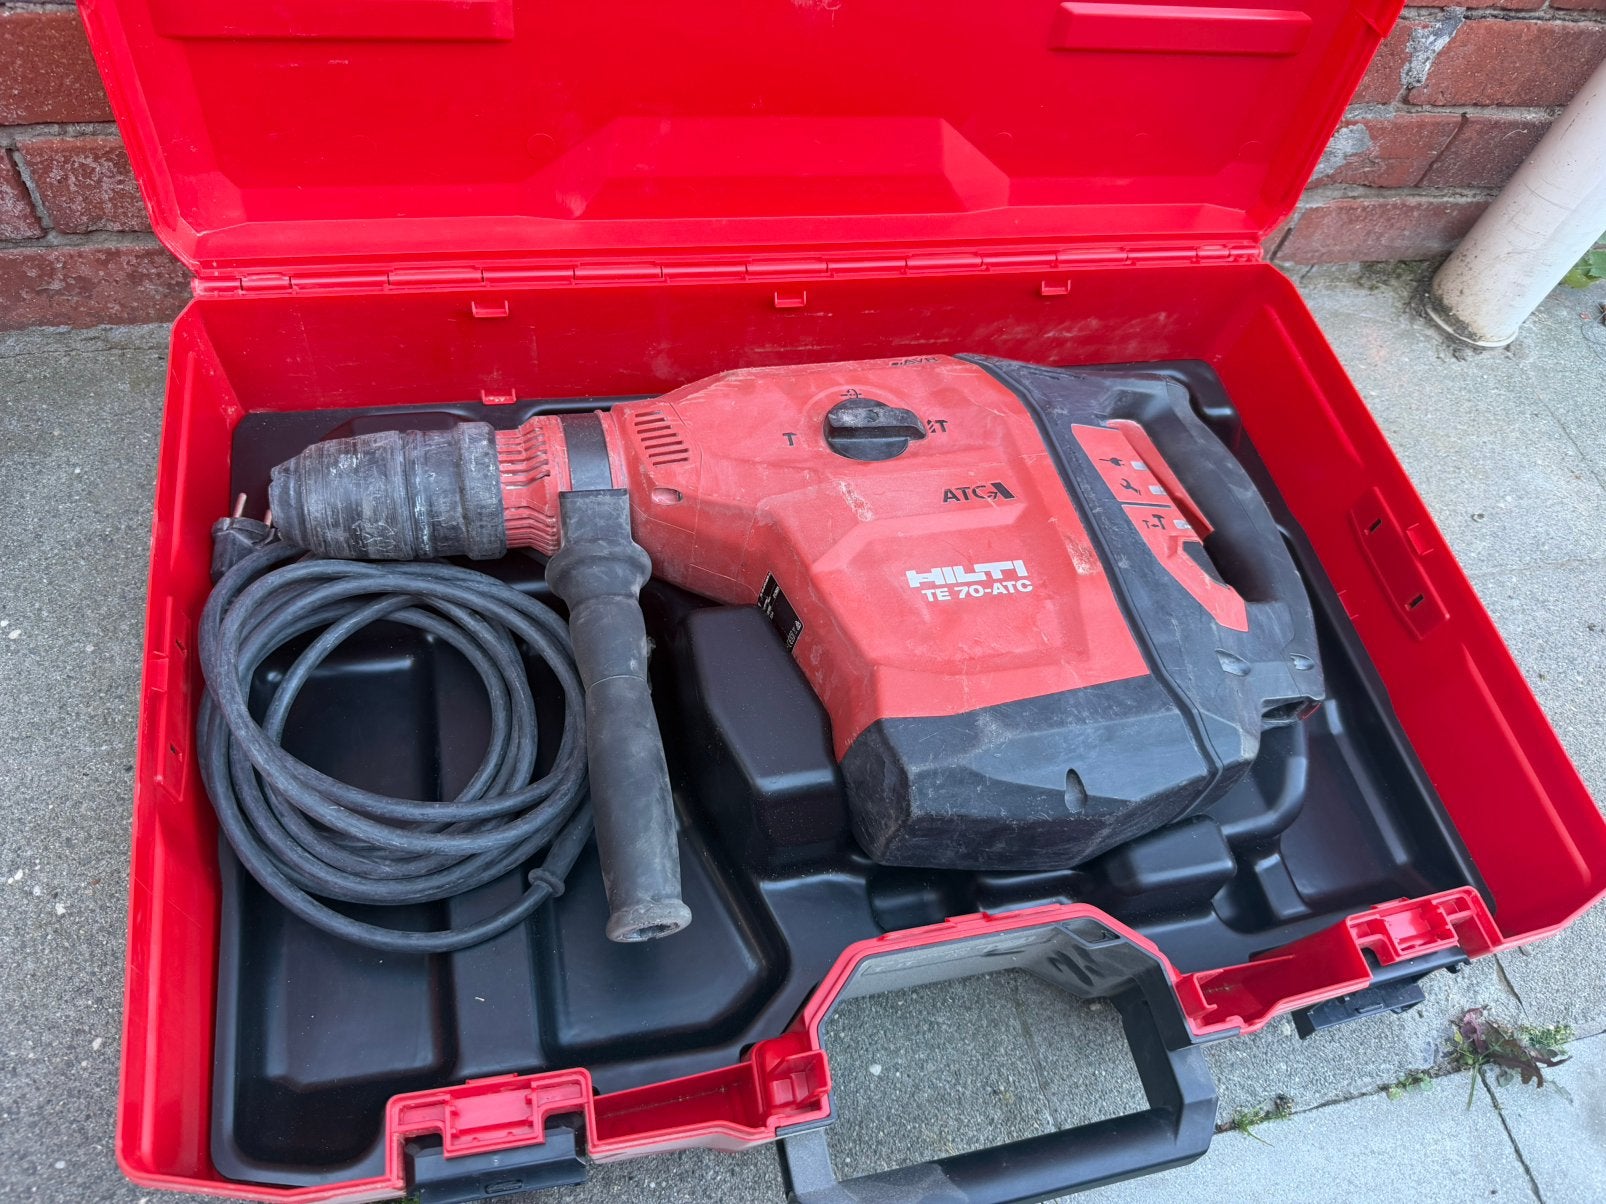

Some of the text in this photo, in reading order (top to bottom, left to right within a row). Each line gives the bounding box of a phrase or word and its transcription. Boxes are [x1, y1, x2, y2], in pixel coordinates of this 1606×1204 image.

[942, 485, 987, 503] ATC
[905, 559, 1028, 588] HILTI
[921, 579, 1033, 602] TE 70-ATC
